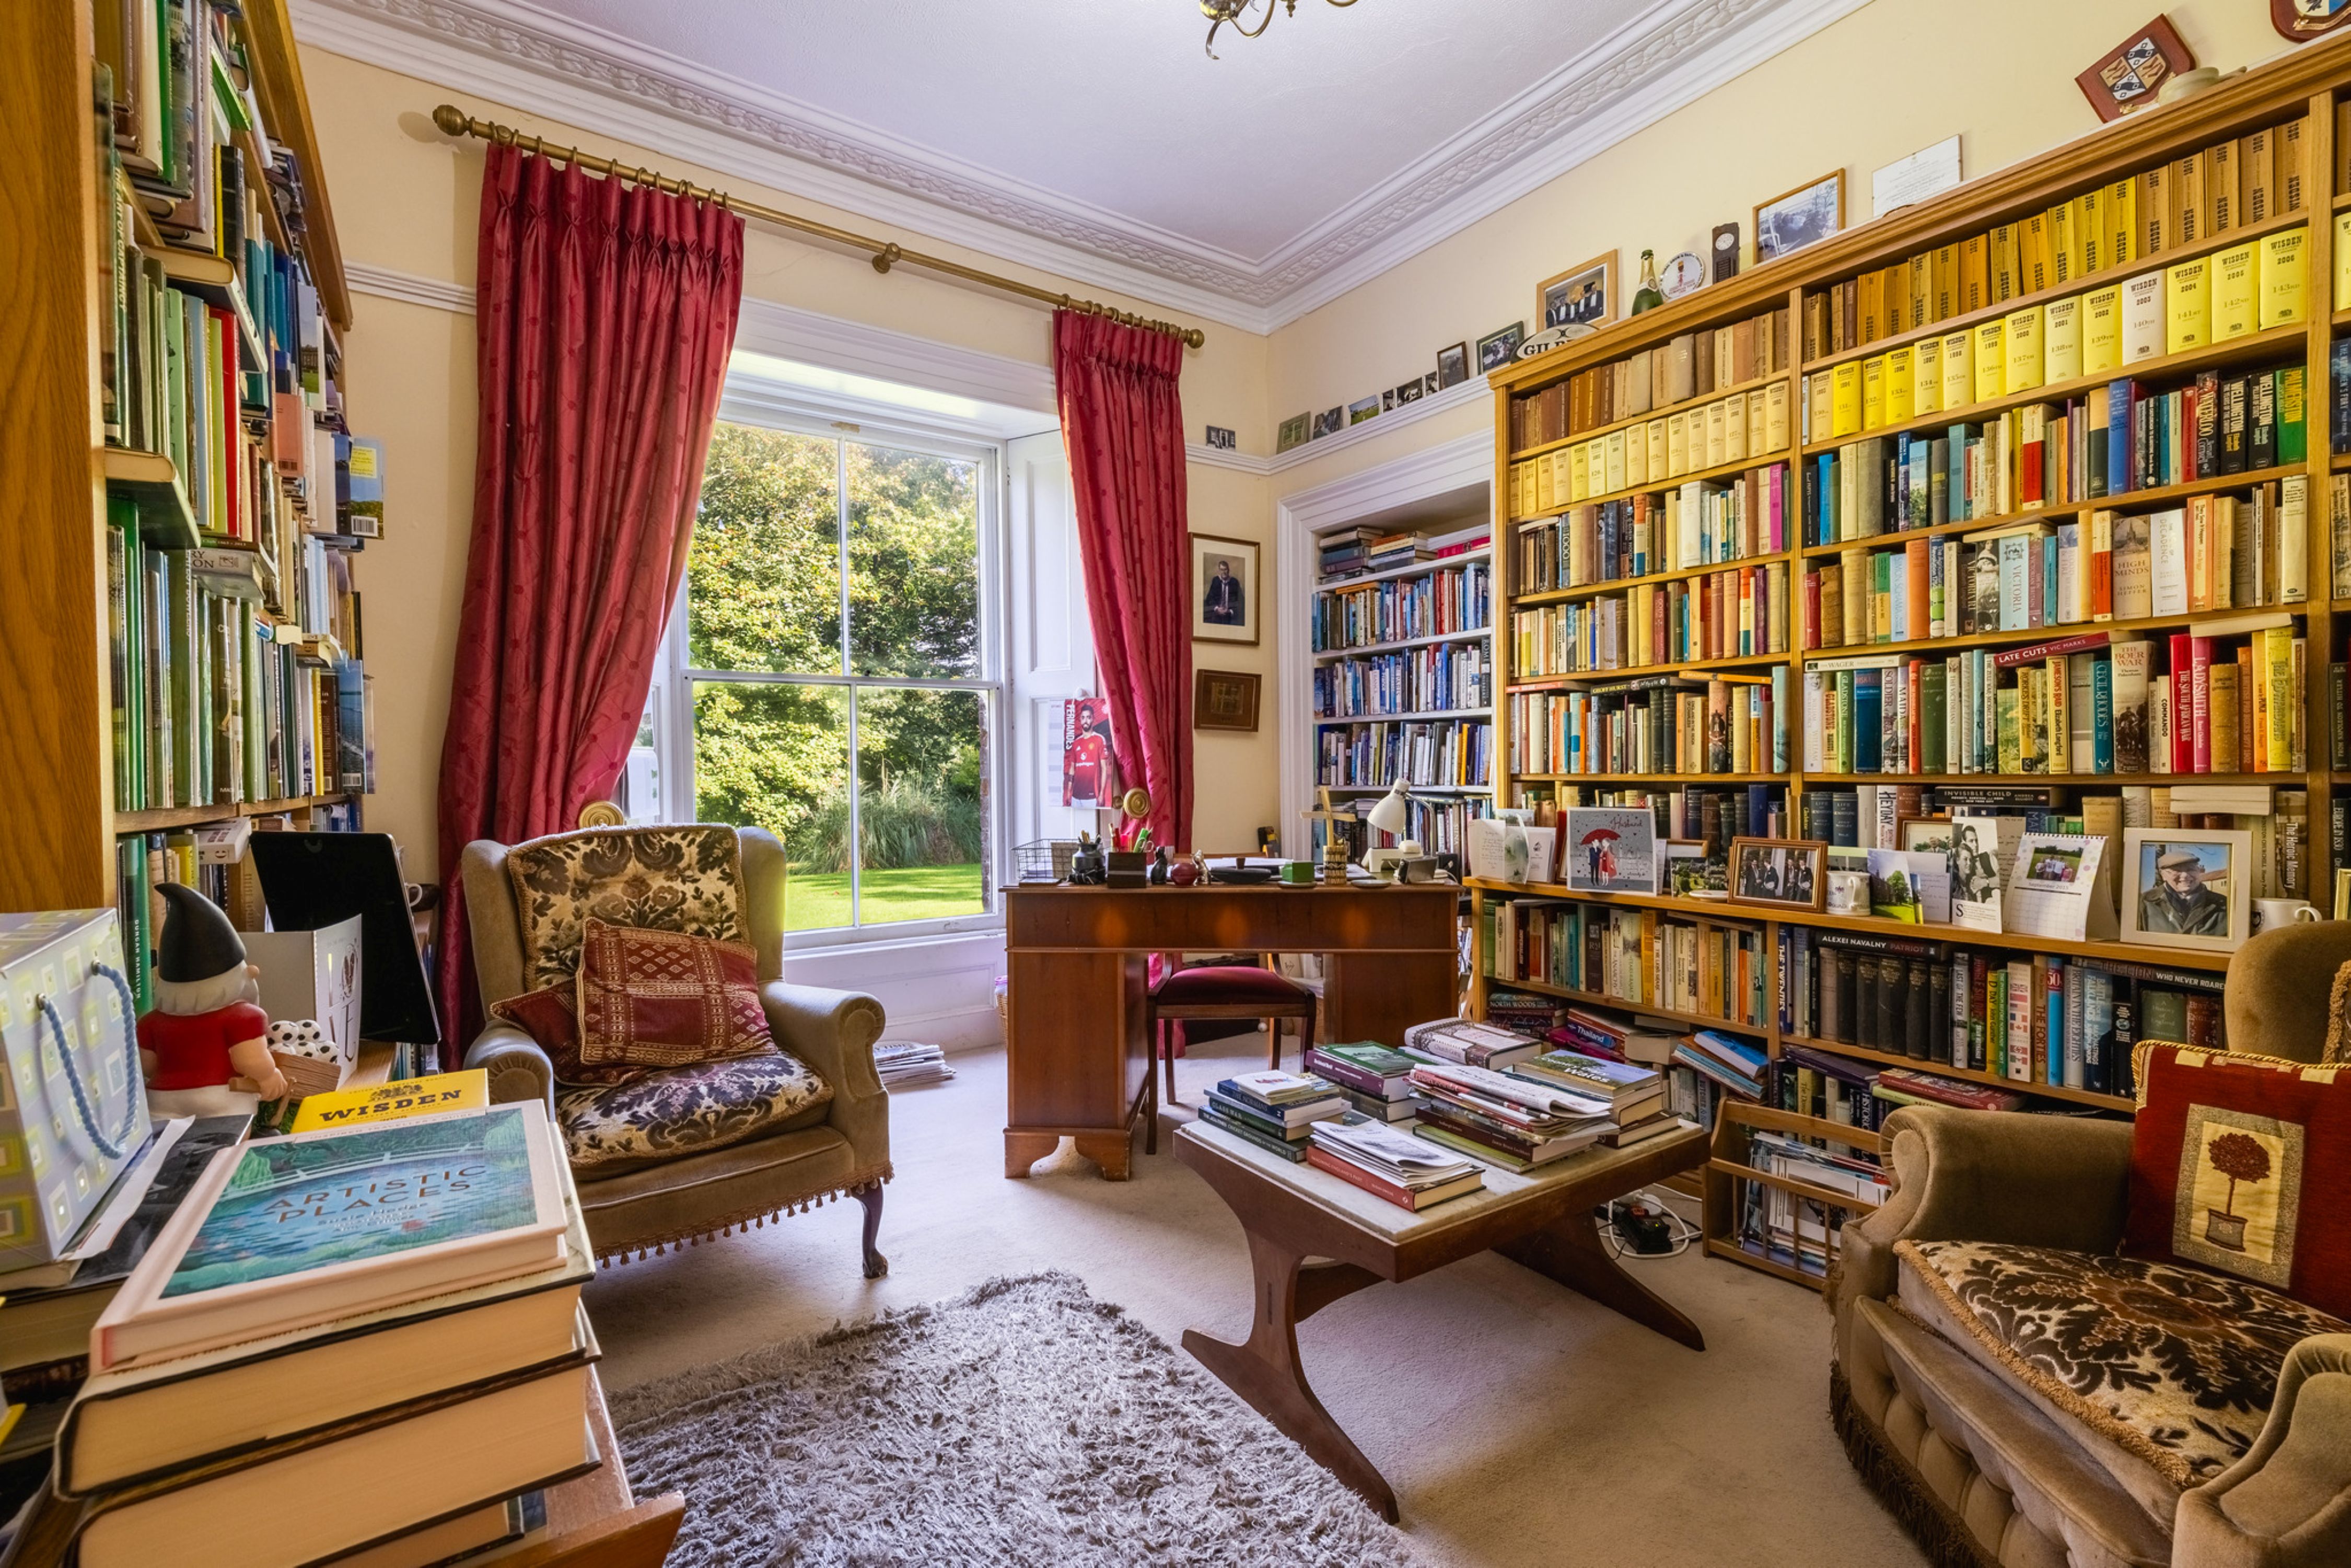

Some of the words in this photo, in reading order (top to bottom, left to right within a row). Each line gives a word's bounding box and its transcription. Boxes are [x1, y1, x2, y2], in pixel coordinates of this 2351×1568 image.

[2253, 188, 2264, 223] WISDEN
[2288, 176, 2300, 212] WISDEN
[2184, 208, 2194, 243] WISDEN
[2217, 197, 2228, 231] WISDEN
[117, 220, 124, 239] OF
[2150, 220, 2160, 254] WISDEN
[2117, 231, 2126, 264] WISDEN
[2271, 236, 2302, 250] WISDEN
[2057, 252, 2067, 284] WISDEN
[2086, 241, 2096, 272] WISDEN
[2222, 252, 2250, 265] WISDEN
[2277, 254, 2295, 265] 2006
[118, 240, 126, 311] CAPTAINCY
[2034, 262, 2044, 292] WISDEN
[2174, 264, 2203, 279] WISDEN
[2000, 272, 2009, 300] WISDEN
[2131, 278, 2157, 292] WISDEN
[2050, 302, 2075, 315] WISDEN
[2089, 292, 2115, 305] WISDEN
[1981, 326, 2002, 336] WISDEN
[2011, 314, 2035, 326] WISDEN
[1919, 341, 1939, 351] WISDEN
[1946, 335, 1966, 345] WISDEN
[1865, 359, 1882, 369] WISDEN
[1890, 351, 1909, 360] WISDEN
[1813, 374, 1830, 383] WISDEN
[1837, 367, 1854, 376] WISDEN
[2231, 380, 2244, 433] WELLINGTON
[2259, 374, 2273, 426] WELLINGTON
[2284, 368, 2302, 423] PALMERSTON
[2340, 393, 2349, 409] FURY
[2198, 392, 2214, 437] WATERLOO
[2159, 518, 2169, 564] DECADENCE
[2115, 566, 2149, 576] MINDS
[2118, 560, 2146, 569] HIGH
[2012, 565, 2022, 613] VICTORIA
[1998, 652, 2020, 663] LATE
[2022, 646, 2047, 658] CUTS
[2063, 639, 2086, 648] MARKS
[2114, 652, 2145, 660] BOER
[2116, 658, 2143, 667] WAR
[1884, 670, 1893, 707] SOLDIER
[2053, 661, 2062, 693] JAMESON'S
[2097, 665, 2107, 691] CECIL
[2194, 657, 2207, 717] LADYSMITH
[1825, 693, 1835, 730] GLADSTONE
[2054, 694, 2062, 707] RAID
[2097, 692, 2108, 727] RHODES
[1065, 704, 1076, 750] FERNANDES
[2054, 710, 2063, 732] Elizabeth
[2054, 733, 2063, 757] Longford
[1611, 811, 1643, 830] Husband
[1879, 791, 1896, 826] HEYDAY
[2286, 822, 2298, 839] The
[2286, 840, 2298, 861] Heroic
[2284, 863, 2298, 889] Memory
[1822, 935, 1849, 944] ALEXEI
[1850, 937, 1887, 949] NAVALNY
[1890, 944, 1925, 954] PATRIOT
[2071, 969, 2081, 997] BRITAIN
[2156, 972, 2174, 981] WHO
[2174, 975, 2198, 985] NEVER
[2199, 979, 2225, 990] ROARE
[1988, 990, 1997, 1005] DAY
[2036, 1005, 2046, 1021] THE
[1577, 1026, 1604, 1043] Thailand
[2036, 1024, 2046, 1064] FORTIES
[319, 1089, 462, 1122] WISDEN
[1227, 1122, 1243, 1134] CRICKET
[1242, 1130, 1262, 1143] GROUNDS
[1271, 1143, 1287, 1155] WORLD
[1310, 1156, 1333, 1170] IMAGINING
[1332, 1164, 1352, 1178] ENGLAND'S
[1352, 1174, 1364, 1183] PAST
[263, 1165, 487, 1216] ARTISTIC
[276, 1180, 471, 1224] PLACES
[316, 1213, 365, 1227] Susie
[371, 1203, 428, 1218] Hodge
